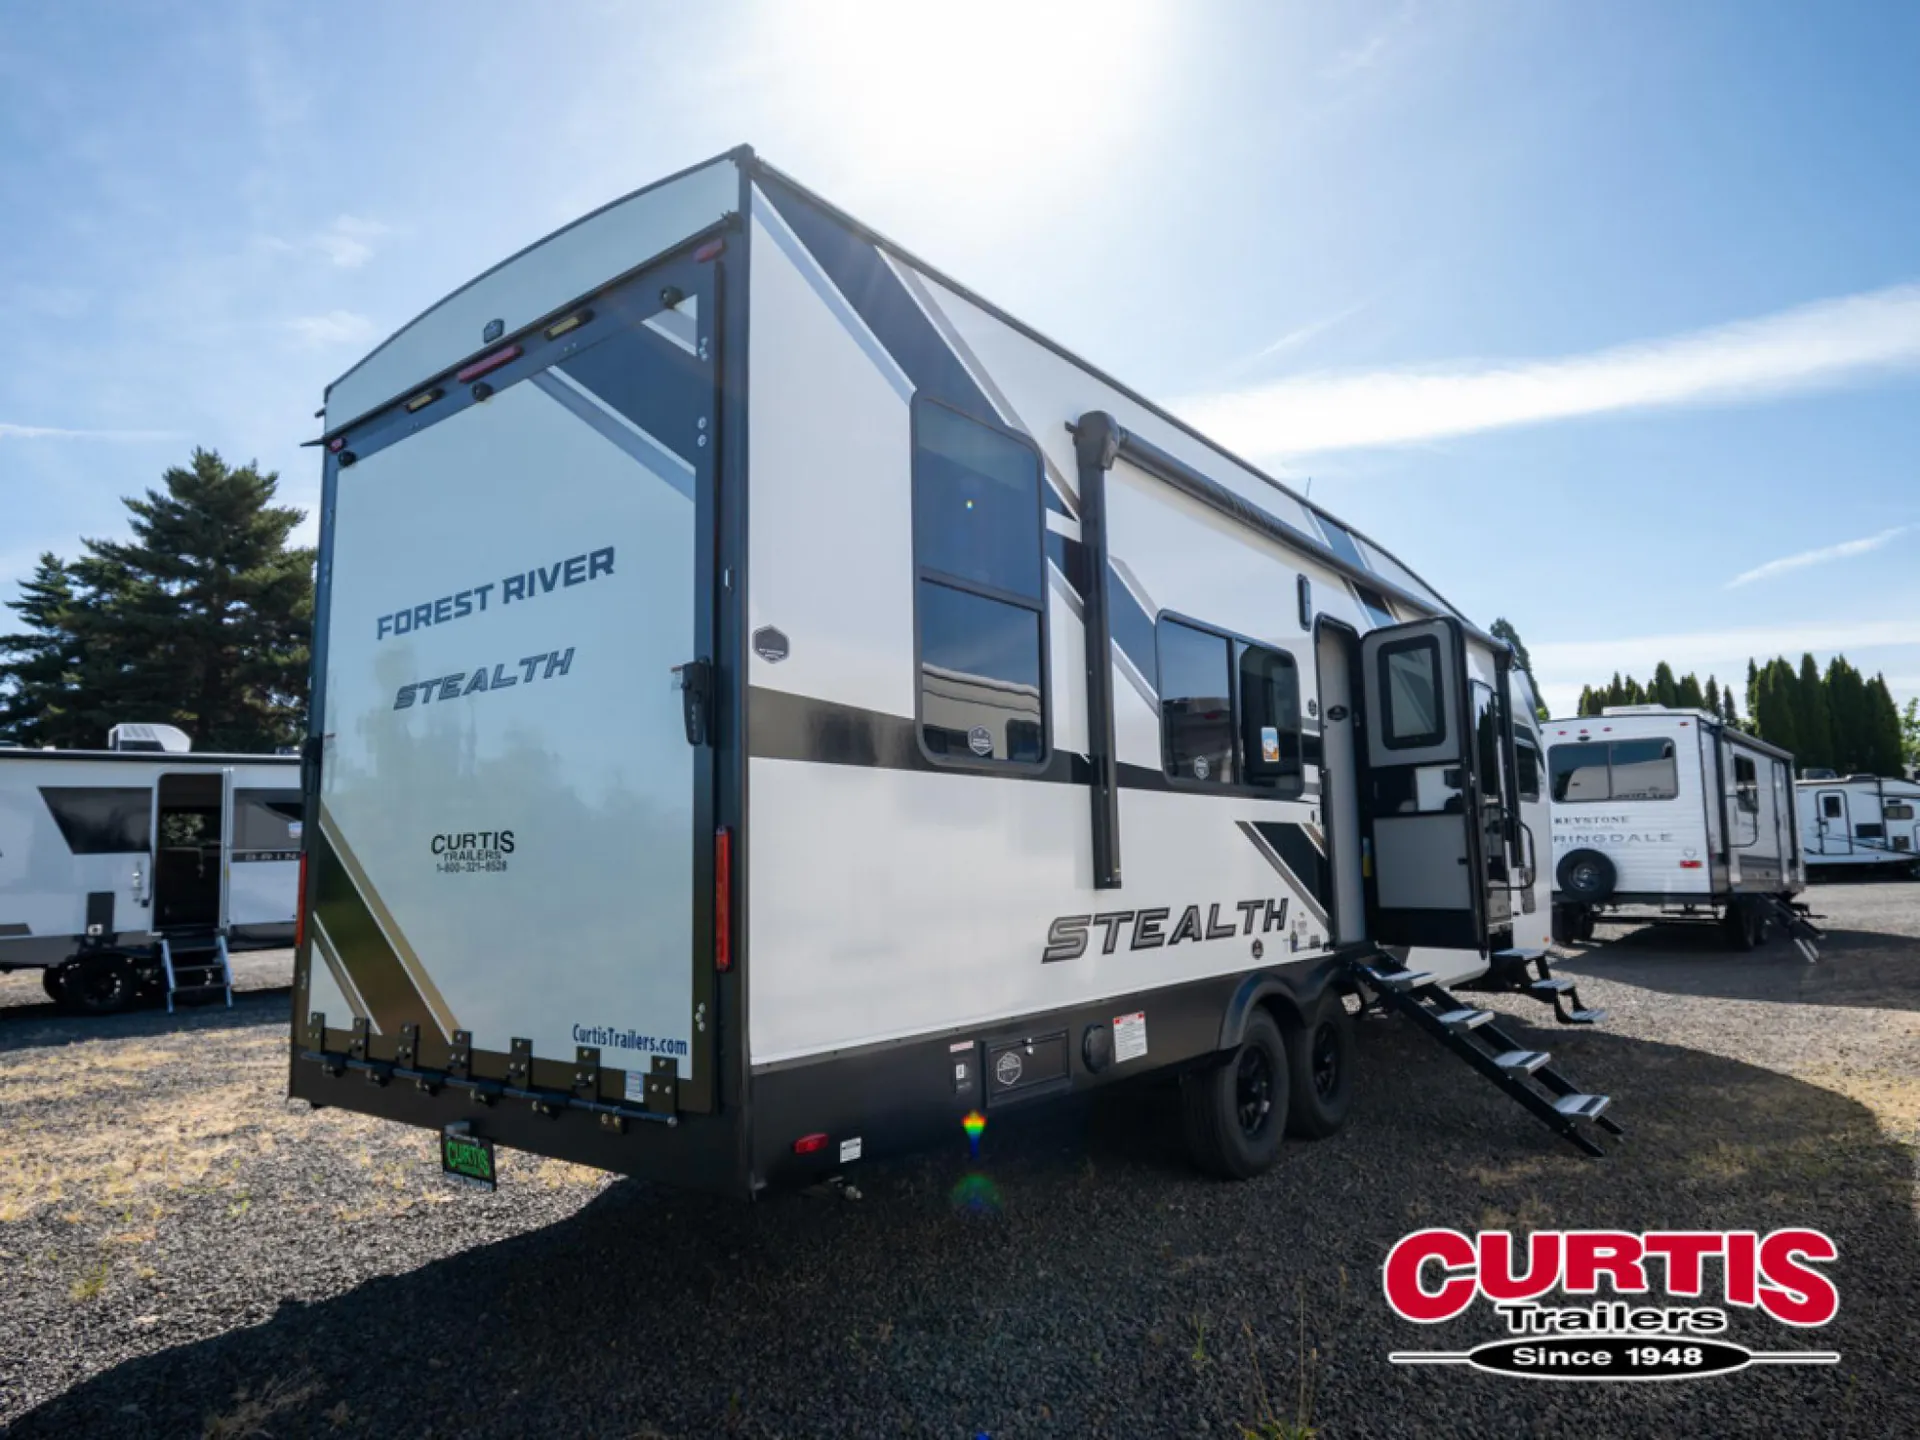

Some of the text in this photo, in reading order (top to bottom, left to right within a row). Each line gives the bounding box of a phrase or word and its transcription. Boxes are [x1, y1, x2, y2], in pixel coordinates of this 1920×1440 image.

[377, 546, 615, 640] FOREST RIVER
[393, 647, 576, 710] STEALTH
[431, 830, 515, 854] CURTIS
[444, 849, 502, 861] TRAILERS
[1041, 897, 1289, 964] STEALTH
[572, 1023, 688, 1056] CurtisTrailers.com
